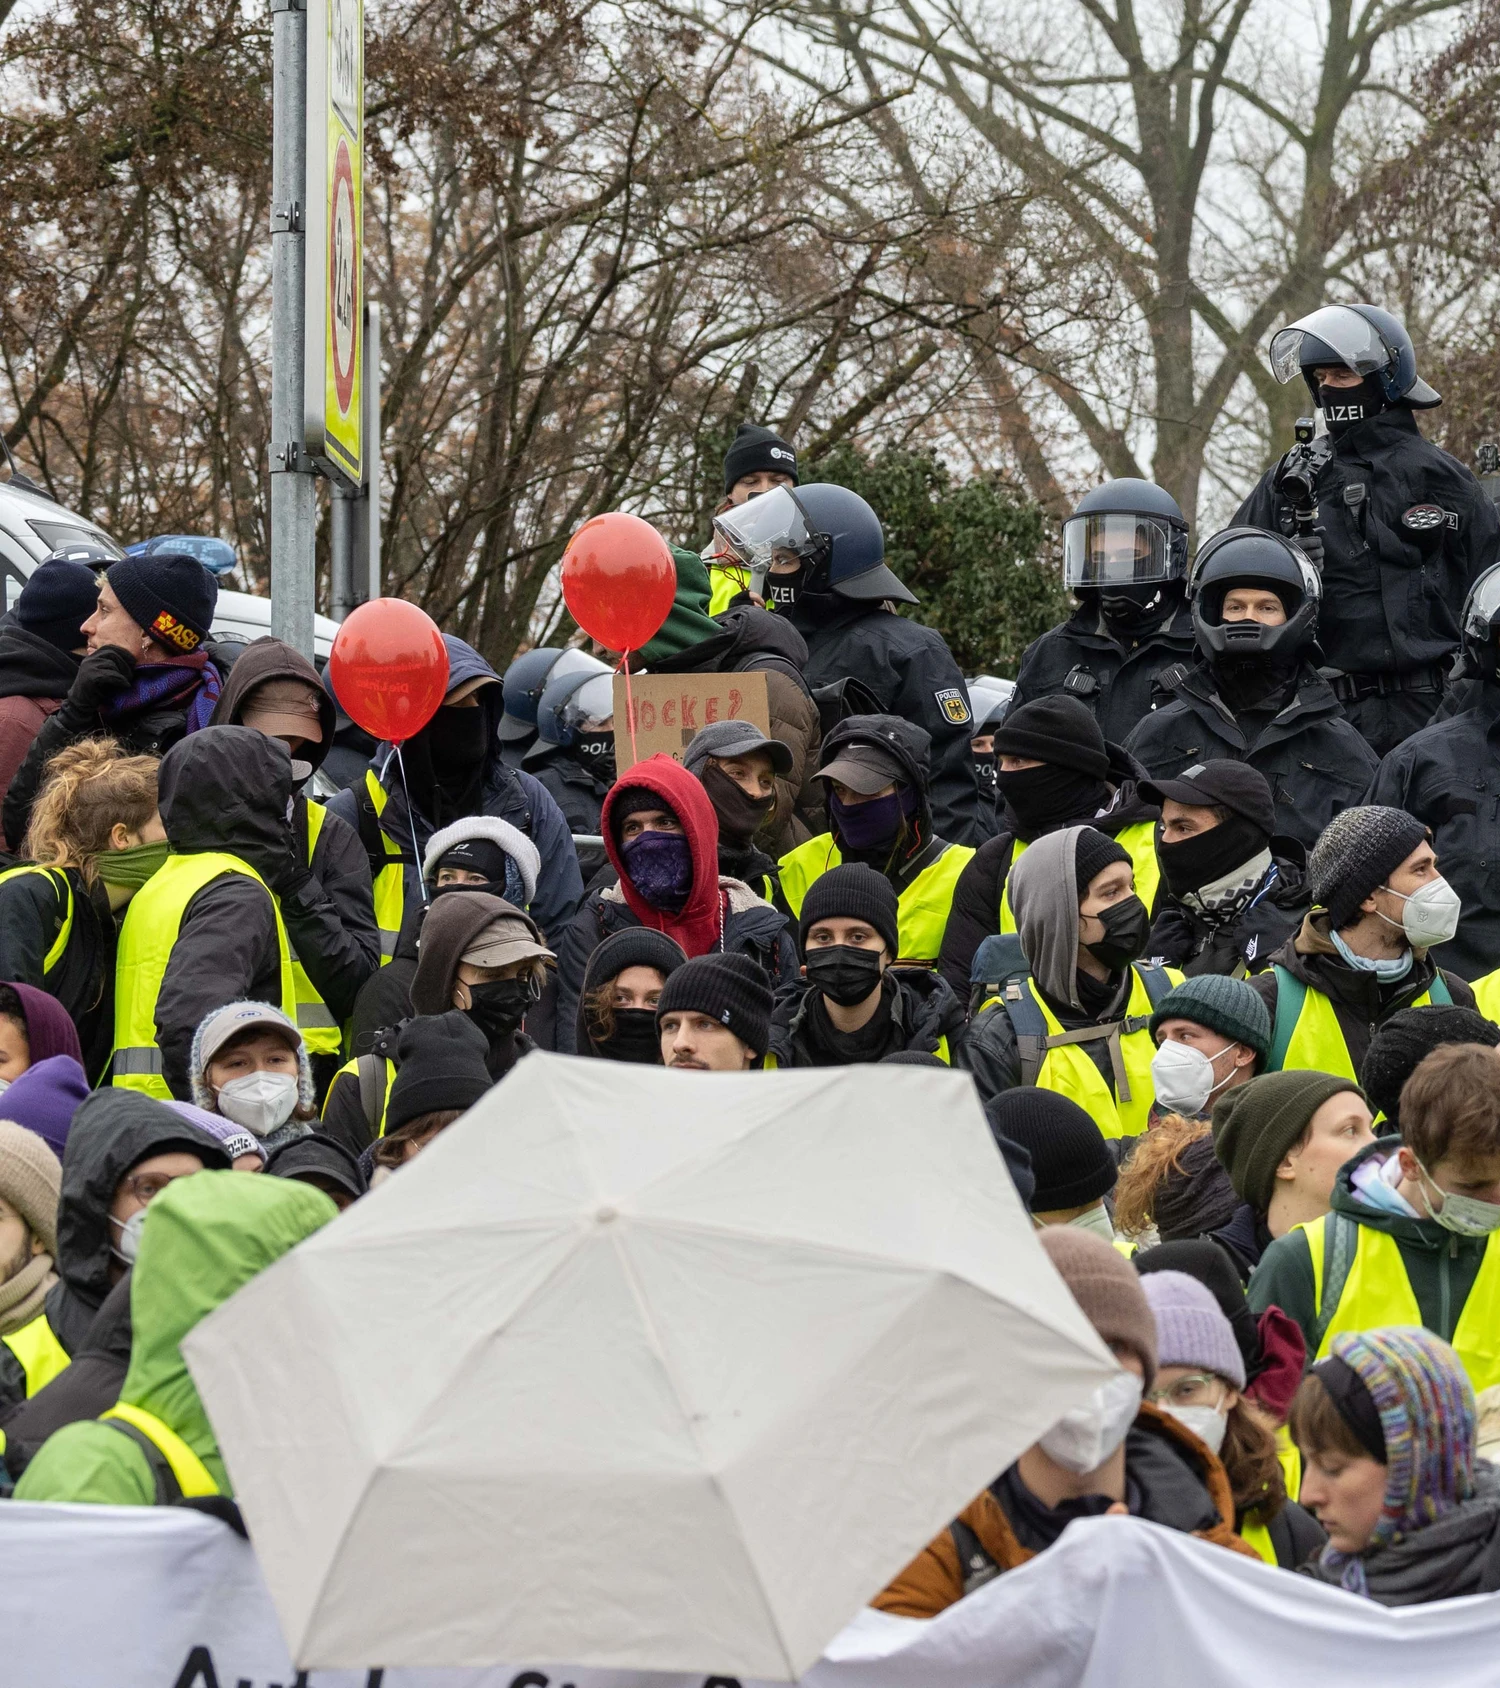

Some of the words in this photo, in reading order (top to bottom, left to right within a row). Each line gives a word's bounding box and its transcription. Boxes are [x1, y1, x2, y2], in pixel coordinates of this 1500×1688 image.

[1324, 405, 1364, 421] LIZEI
[166, 624, 200, 651] ASB
[938, 689, 961, 702] POLIZEI
